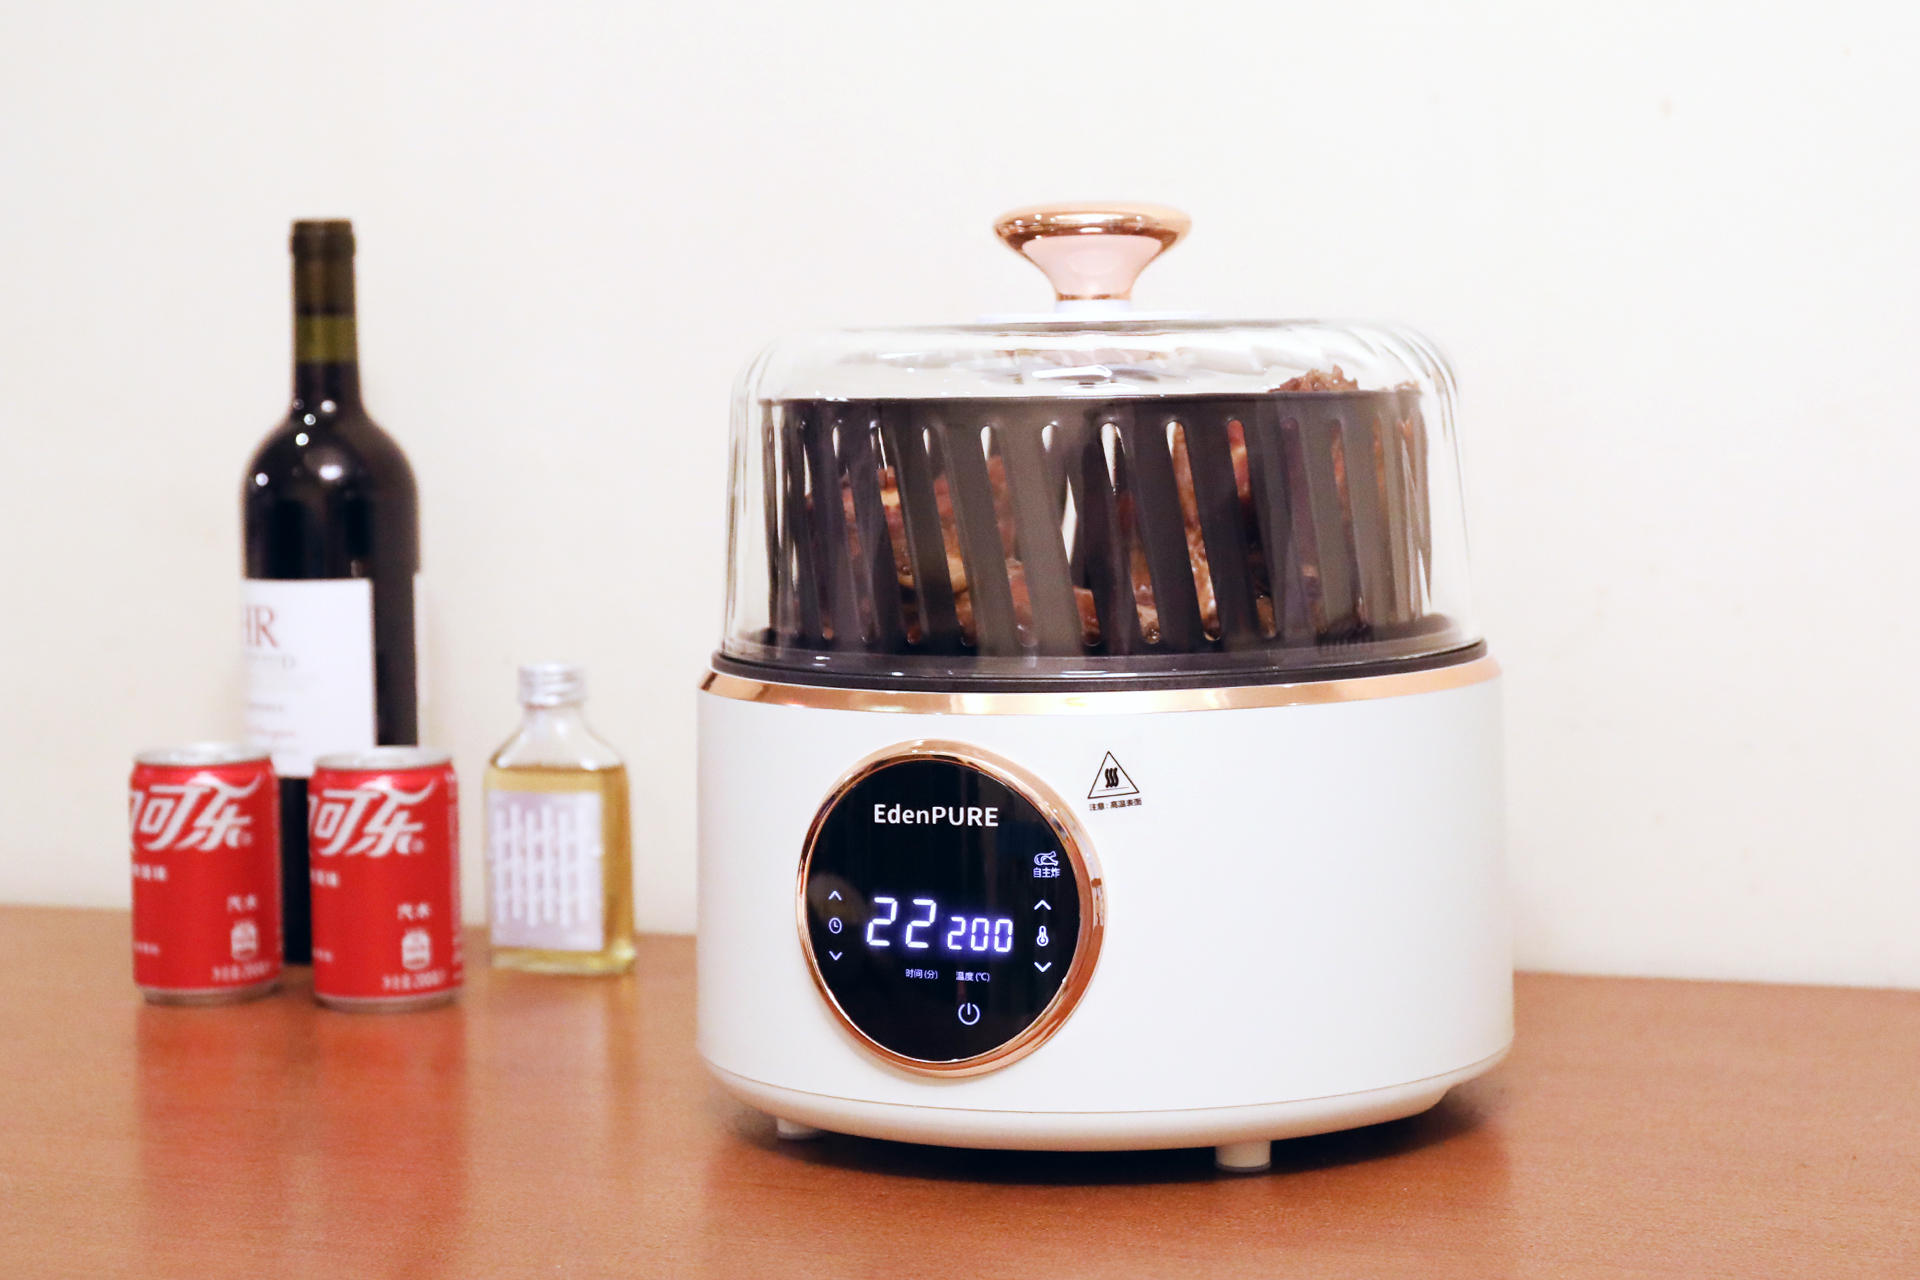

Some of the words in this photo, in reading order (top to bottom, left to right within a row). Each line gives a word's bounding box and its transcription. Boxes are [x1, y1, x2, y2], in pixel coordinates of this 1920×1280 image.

[873, 803, 999, 827] EdenPURE
[1033, 867, 1061, 878] 自主炸
[866, 896, 937, 948] 22
[947, 916, 1013, 952] 200
